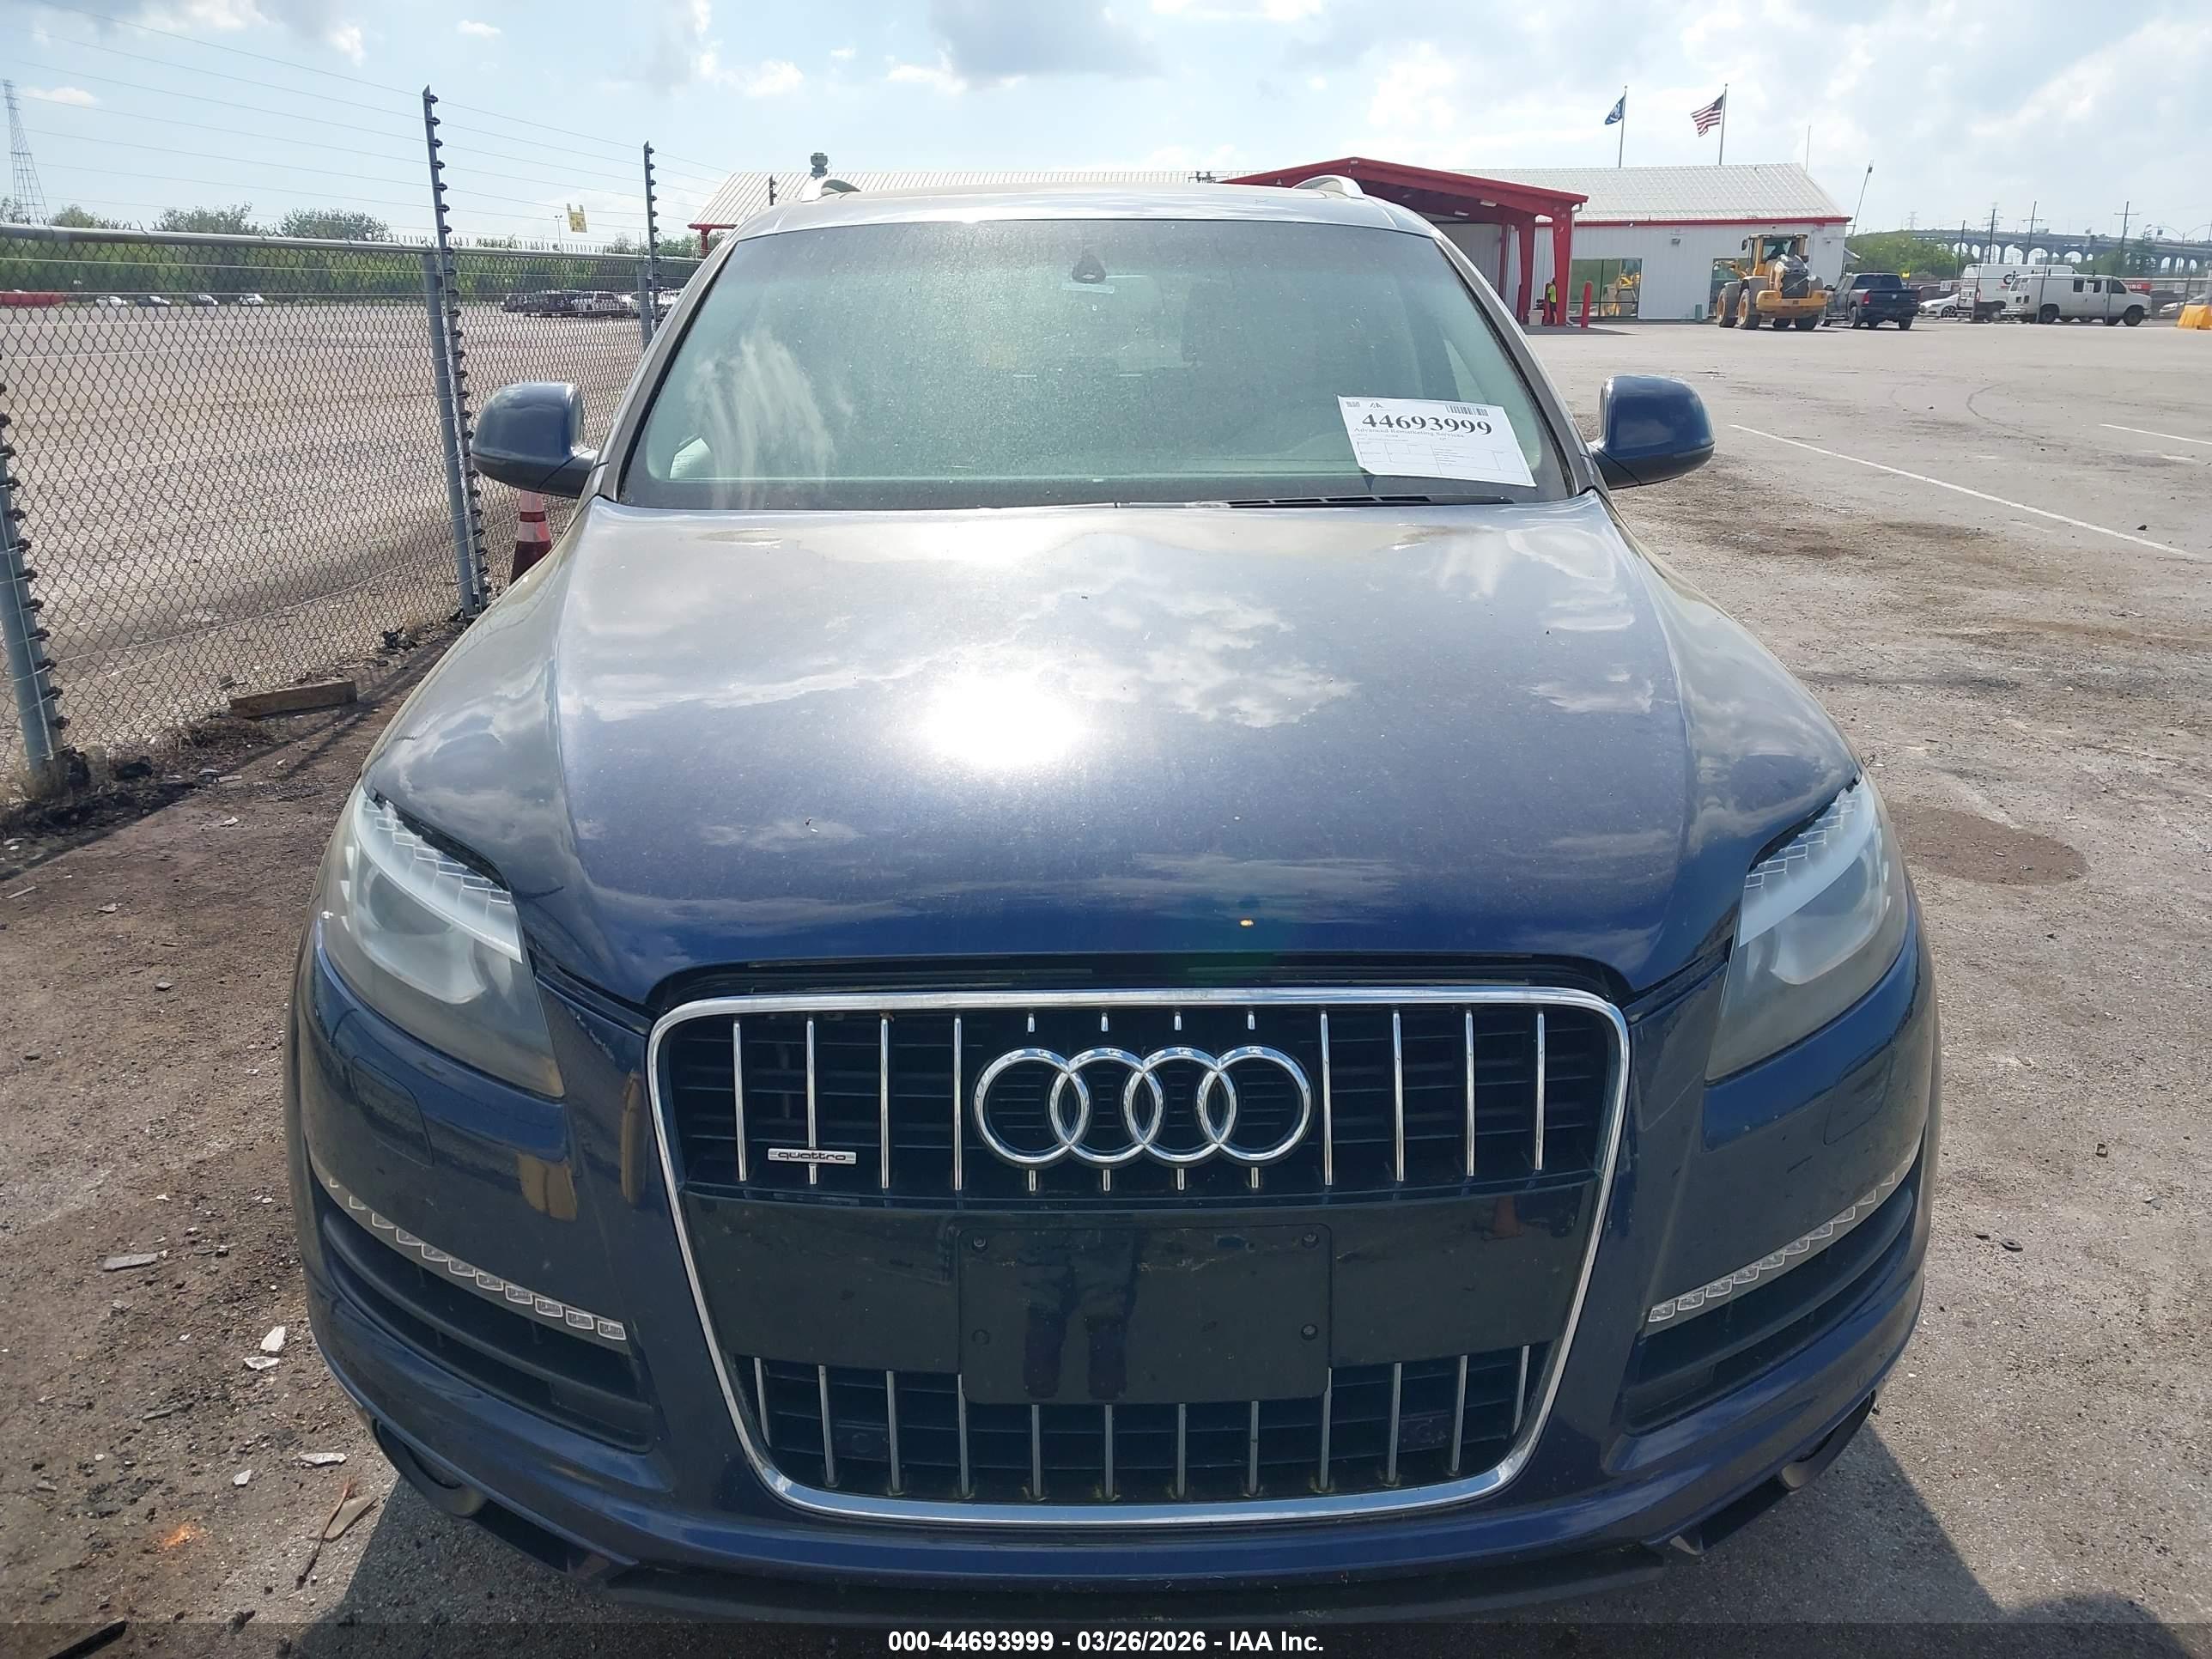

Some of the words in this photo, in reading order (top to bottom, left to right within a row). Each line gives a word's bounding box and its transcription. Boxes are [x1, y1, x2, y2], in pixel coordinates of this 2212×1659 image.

[1362, 413, 1492, 435] 44693999
[1391, 428, 1434, 437] Remarketing
[777, 1152, 846, 1160] quattro
